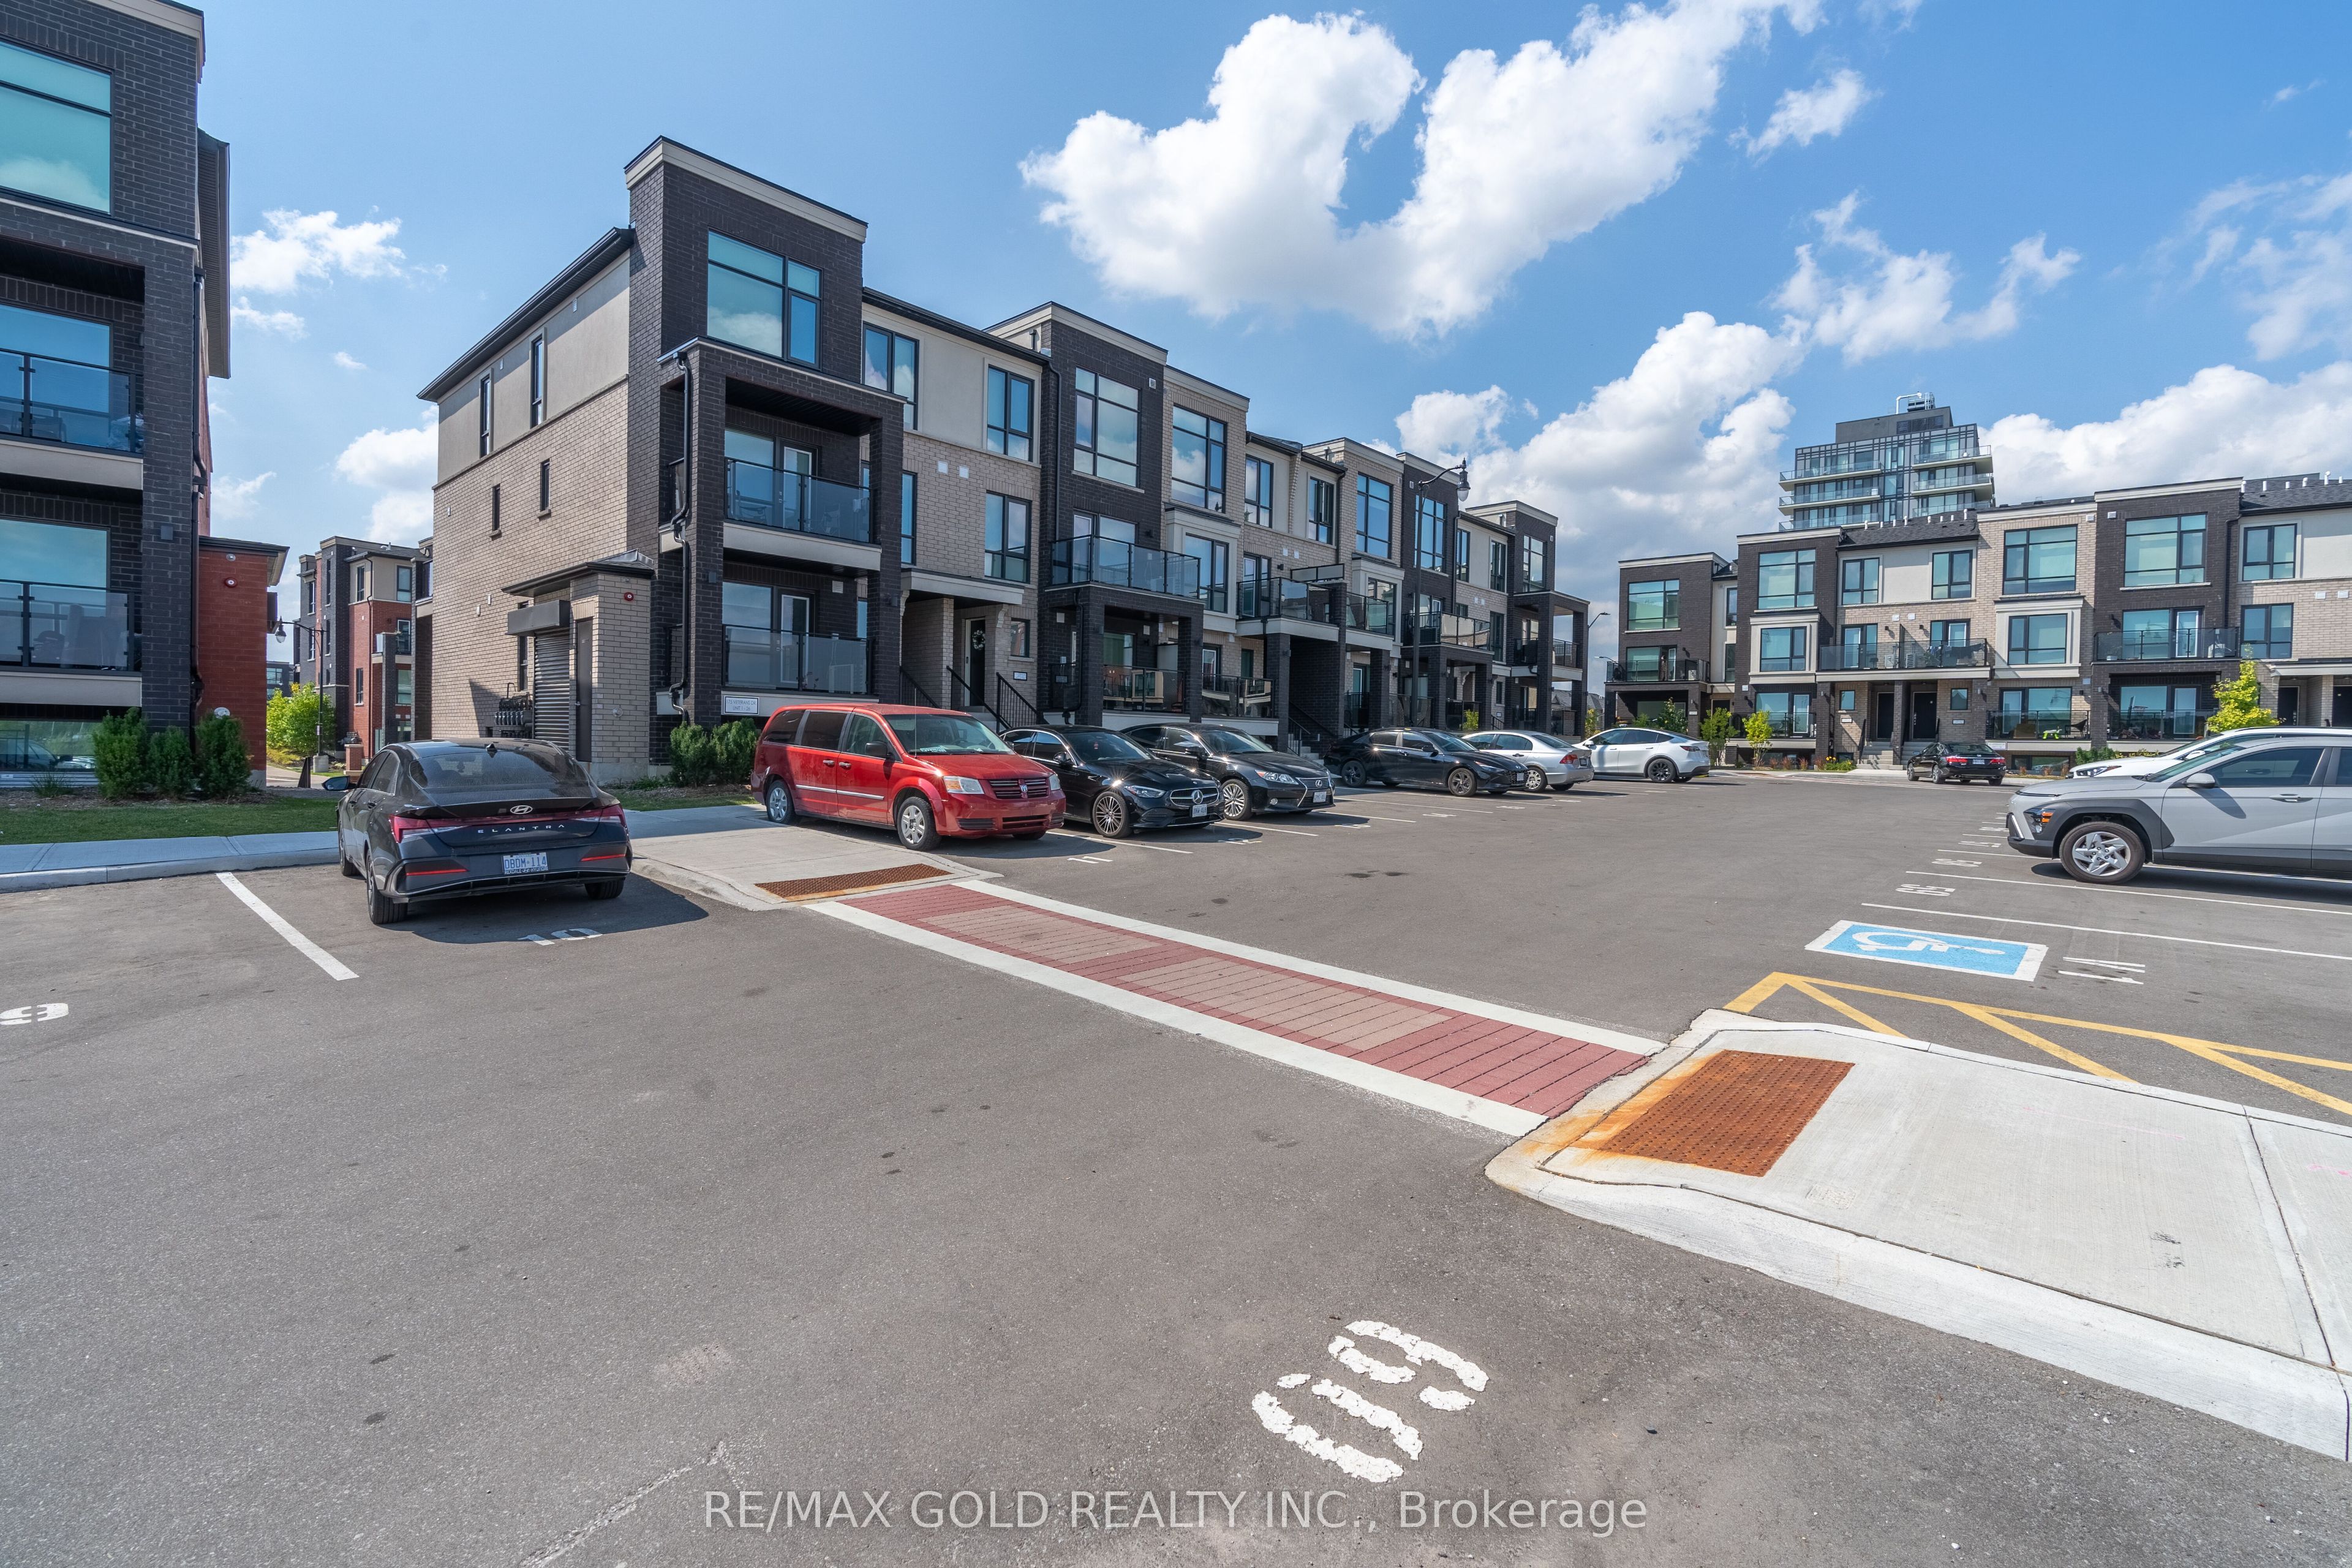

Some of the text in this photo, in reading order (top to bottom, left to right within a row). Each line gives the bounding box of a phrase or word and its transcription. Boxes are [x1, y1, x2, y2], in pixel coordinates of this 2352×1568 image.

[478, 824, 564, 833] ELANTRA
[1895, 884, 1956, 897] 59
[517, 928, 603, 946] 10
